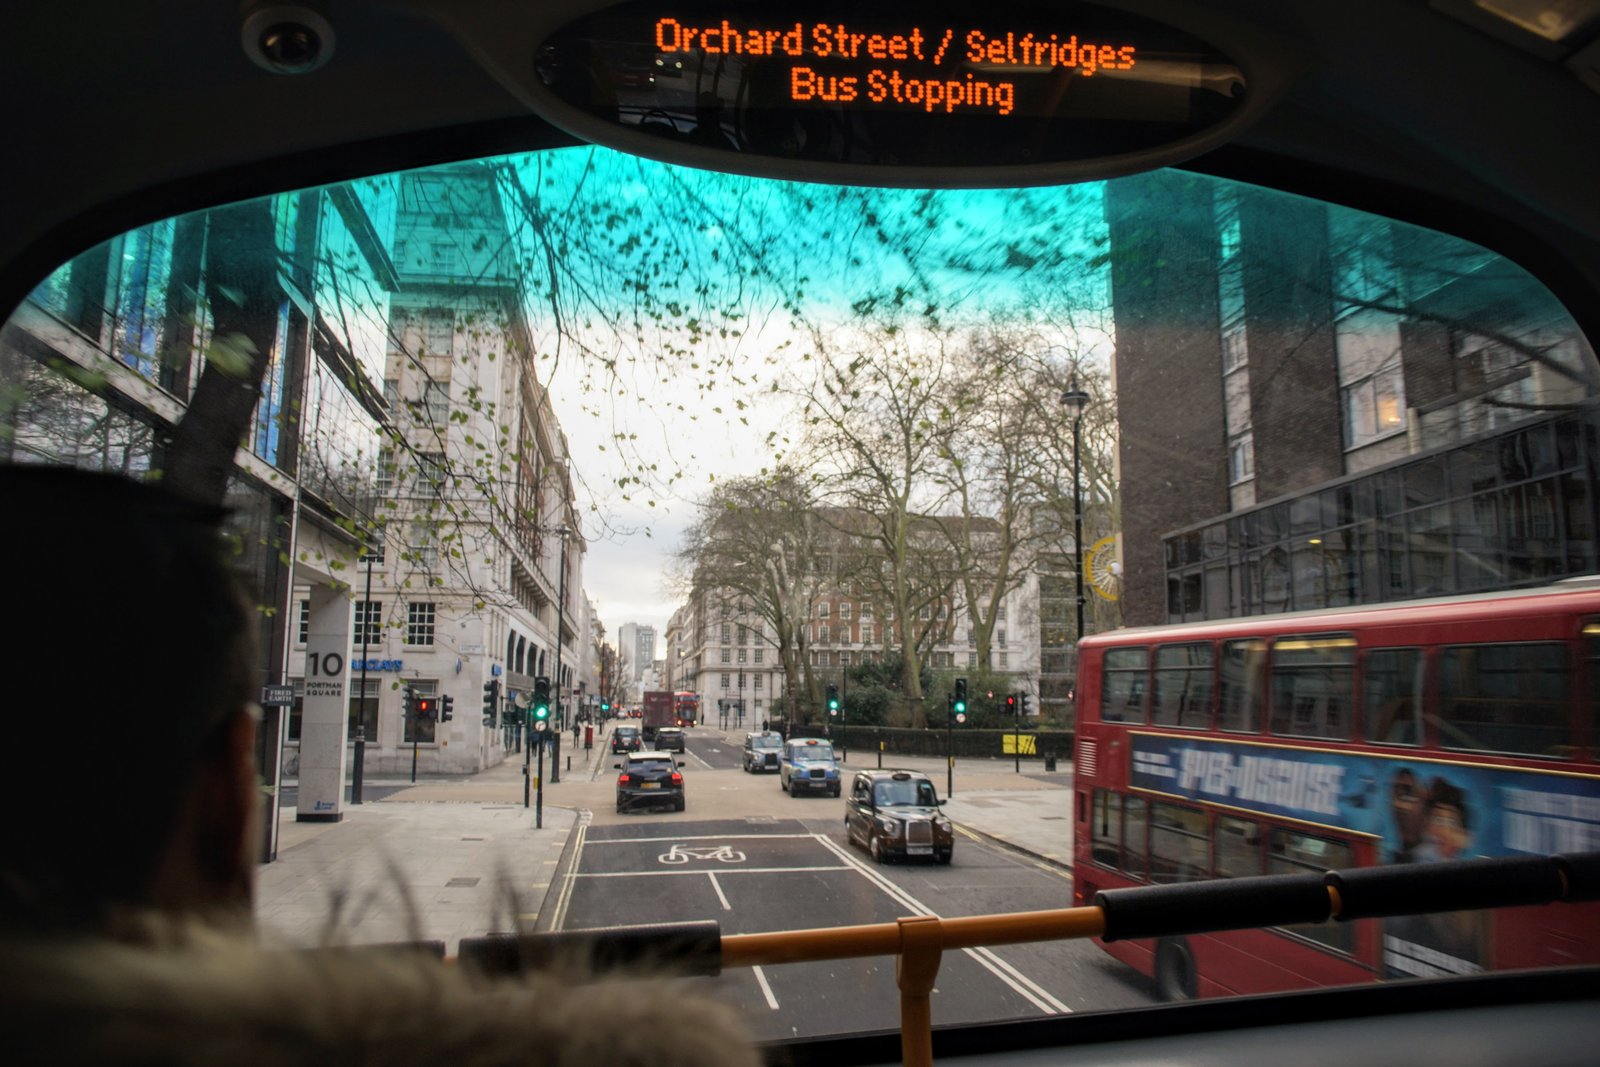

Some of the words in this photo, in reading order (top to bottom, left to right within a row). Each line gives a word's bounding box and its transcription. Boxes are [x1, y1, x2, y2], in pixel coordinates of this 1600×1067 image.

[655, 17, 803, 56] Orchard
[812, 23, 925, 61] Street
[933, 28, 953, 65] /
[966, 30, 1136, 77] Selfridges
[791, 66, 858, 102] Bus
[867, 69, 1014, 115] Stopping
[308, 652, 343, 677] 10
